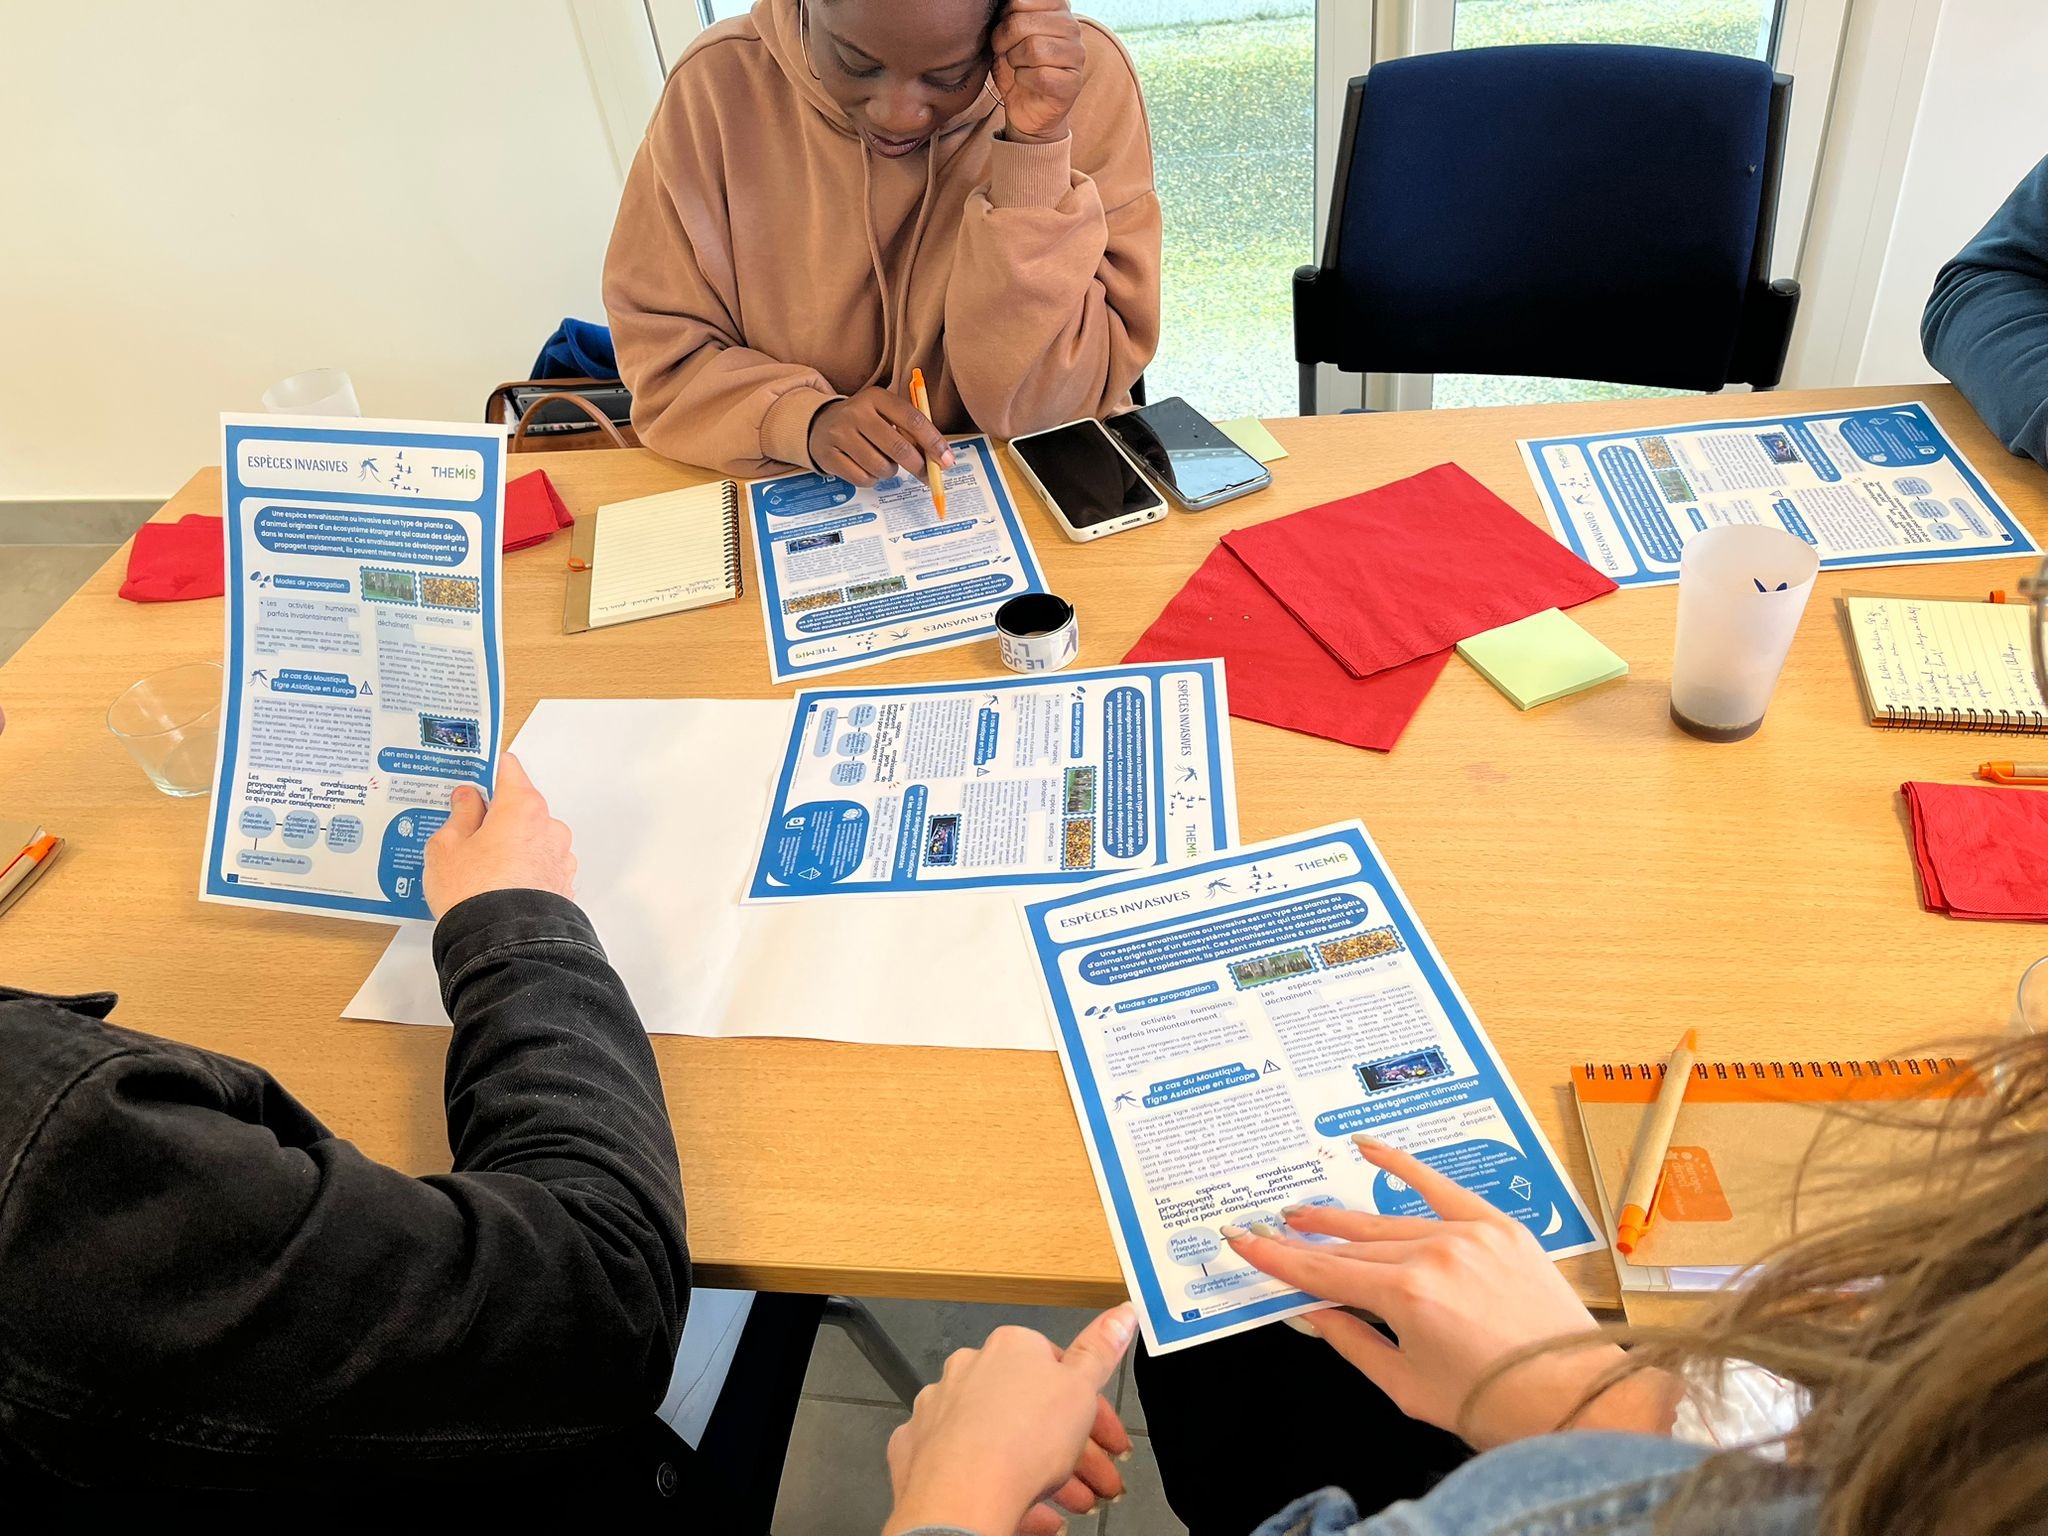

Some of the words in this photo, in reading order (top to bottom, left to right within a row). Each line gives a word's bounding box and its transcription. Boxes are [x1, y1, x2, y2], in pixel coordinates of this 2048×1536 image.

[247, 454, 292, 469] ESPÈCES
[294, 458, 348, 472] INVASIVES
[284, 511, 307, 519] espèce
[307, 513, 348, 521] envahissante
[357, 515, 381, 524] invasive
[399, 519, 414, 528] type
[423, 521, 443, 529] plante
[274, 577, 296, 585] Modes
[306, 580, 345, 589] propagation
[922, 614, 979, 633] INVASIVES
[795, 645, 838, 659] THEMIS
[1025, 658, 1045, 670] LE
[273, 680, 289, 689] Tigre
[290, 682, 321, 692] Asiatique
[331, 686, 354, 695] Europe
[312, 674, 346, 684] Moustique
[1178, 679, 1191, 713] ESPÈCES
[1179, 714, 1192, 757] INVASIVES
[245, 786, 285, 797] biodiversité
[288, 790, 305, 799] dans
[246, 781, 286, 790] provoquent
[247, 772, 259, 780] Les
[276, 776, 302, 784] espèces
[319, 780, 367, 791] envahissantes
[288, 799, 331, 809] conséquence
[1060, 906, 1118, 927] ESPÈCES
[1120, 890, 1190, 913] INVASIVES
[1087, 955, 1123, 968] d'animal
[1123, 947, 1162, 960] originaire
[1163, 943, 1181, 951] d'un
[1181, 931, 1230, 946] écosystème
[1231, 922, 1265, 935] étranger
[1276, 915, 1290, 925] qui
[1290, 911, 1315, 920] cause
[1316, 906, 1331, 914] des
[1331, 899, 1360, 910] dégâts
[1099, 949, 1116, 957] Une
[1116, 943, 1146, 953] espèce
[1146, 930, 1200, 946] envahissante
[1212, 919, 1246, 930] invasive
[1272, 908, 1291, 917] type
[1303, 899, 1329, 910] plante
[1089, 967, 1110, 976] dans
[1119, 958, 1147, 969] nouvel
[1212, 940, 1228, 948] Ces
[1229, 927, 1283, 944] envahisseurs
[1294, 911, 1345, 928] développent
[1108, 966, 1152, 982] propagent
[1213, 943, 1247, 957] peuvent
[1248, 937, 1275, 948] même
[1275, 932, 1297, 941] nuire
[1304, 925, 1327, 934] notre
[1287, 978, 1322, 990] espèces
[1334, 966, 1375, 979] exotiques
[1118, 999, 1145, 1010] Modes
[1146, 996, 1158, 1004] de
[1159, 984, 1211, 1002] propagation
[1264, 989, 1312, 1006] déchaînent
[1115, 1030, 1144, 1043] parfois
[1145, 1012, 1217, 1034] involontairement
[1140, 1014, 1176, 1026] activités
[1145, 1094, 1168, 1104] Tigre
[1170, 1083, 1210, 1099] Asiatique
[1212, 1080, 1223, 1088] en
[1225, 1072, 1255, 1084] Europe
[1164, 1081, 1181, 1090] cas
[1182, 1077, 1194, 1085] du
[1196, 1065, 1241, 1081] Moustique
[1317, 1114, 1336, 1124] Lien
[1336, 1108, 1361, 1119] entre
[1372, 1090, 1430, 1110] dérèglement
[1430, 1079, 1478, 1095] climatique
[1338, 1121, 1349, 1129] et
[1348, 1119, 1363, 1127] les
[1364, 1109, 1402, 1123] espèces
[1402, 1092, 1468, 1114] envahissantes
[1154, 1197, 1171, 1205] Les
[1195, 1181, 1231, 1195] espèces
[1255, 1159, 1321, 1179] envahissantes
[1157, 1192, 1214, 1215] provoquent
[1231, 1185, 1249, 1194] une
[1267, 1174, 1293, 1187] perte
[1311, 1165, 1323, 1174] de
[1158, 1200, 1215, 1221] biodiversité
[1220, 1195, 1244, 1205] dans
[1162, 1221, 1173, 1229] ce
[1174, 1217, 1190, 1227] qui
[1199, 1208, 1222, 1221] pour
[1224, 1193, 1284, 1213] conséquence
